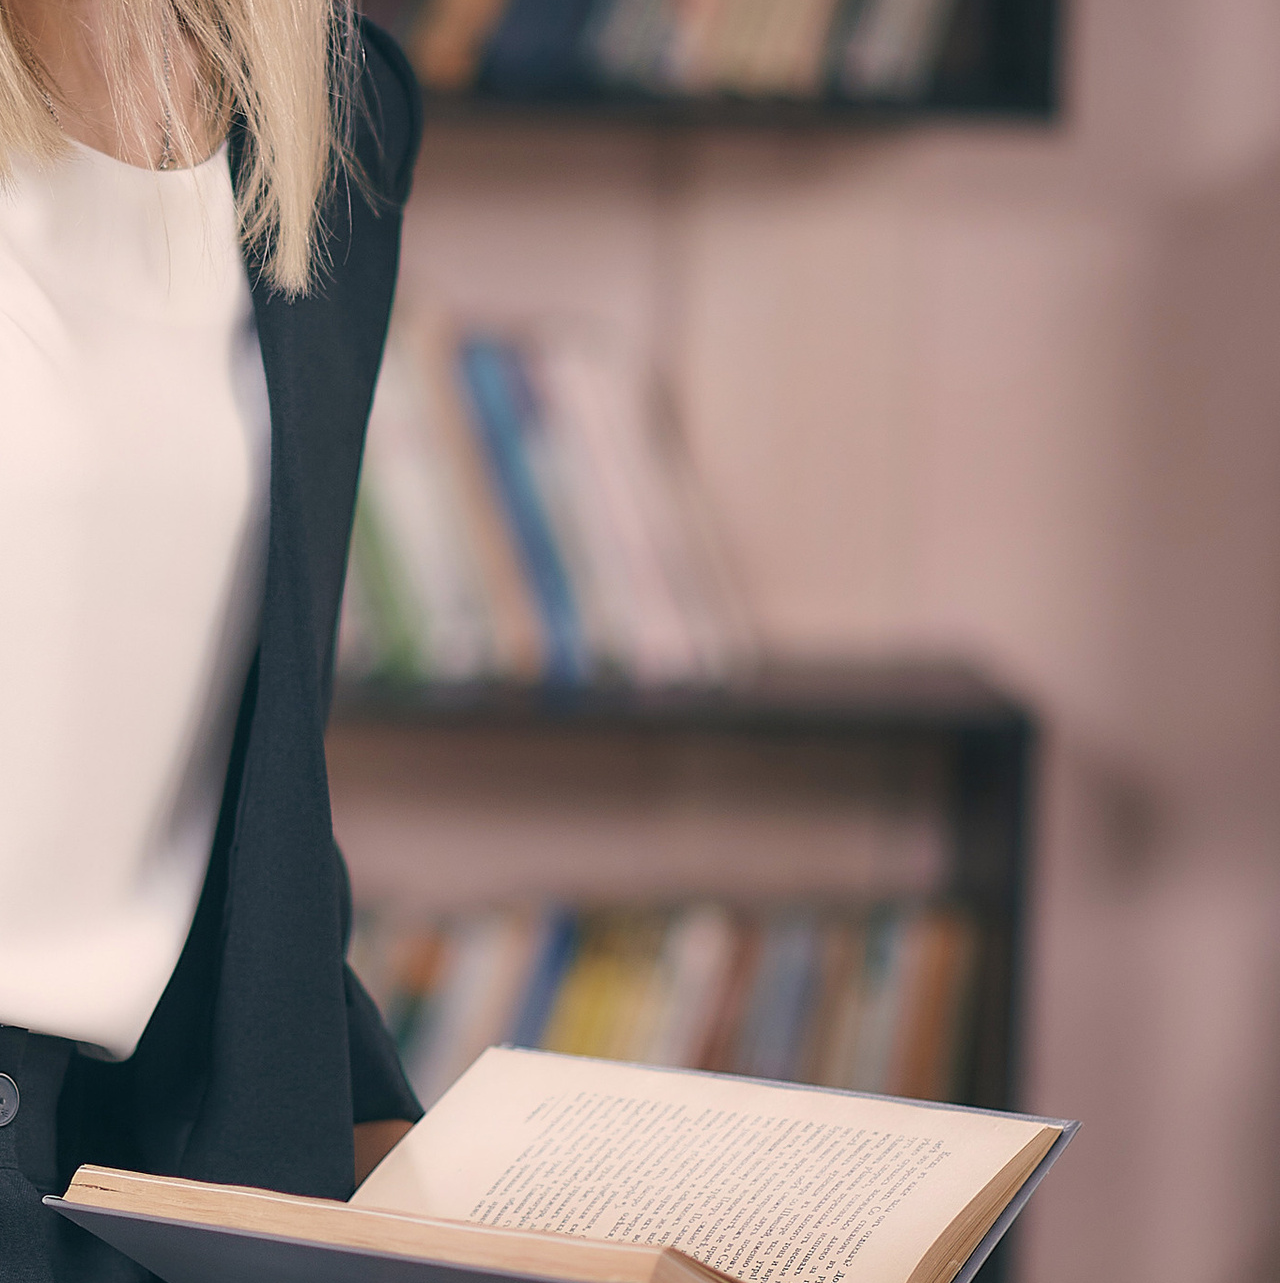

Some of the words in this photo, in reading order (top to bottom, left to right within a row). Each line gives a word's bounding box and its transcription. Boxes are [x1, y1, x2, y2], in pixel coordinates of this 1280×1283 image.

[705, 1195, 731, 1217] Петръ
[685, 1220, 708, 1245] сильно
[788, 1213, 815, 1240] плохого
[835, 1219, 868, 1255] стаканомъ
[722, 1238, 751, 1272] пословъ,
[741, 1240, 764, 1267] именно
[763, 1239, 779, 1256] часа
[775, 1242, 792, 1259] тона
[792, 1232, 828, 1276] испытывалъ
[815, 1235, 840, 1260] далеко
[746, 1260, 767, 1281] утра!
[778, 1247, 802, 1276] веселья
